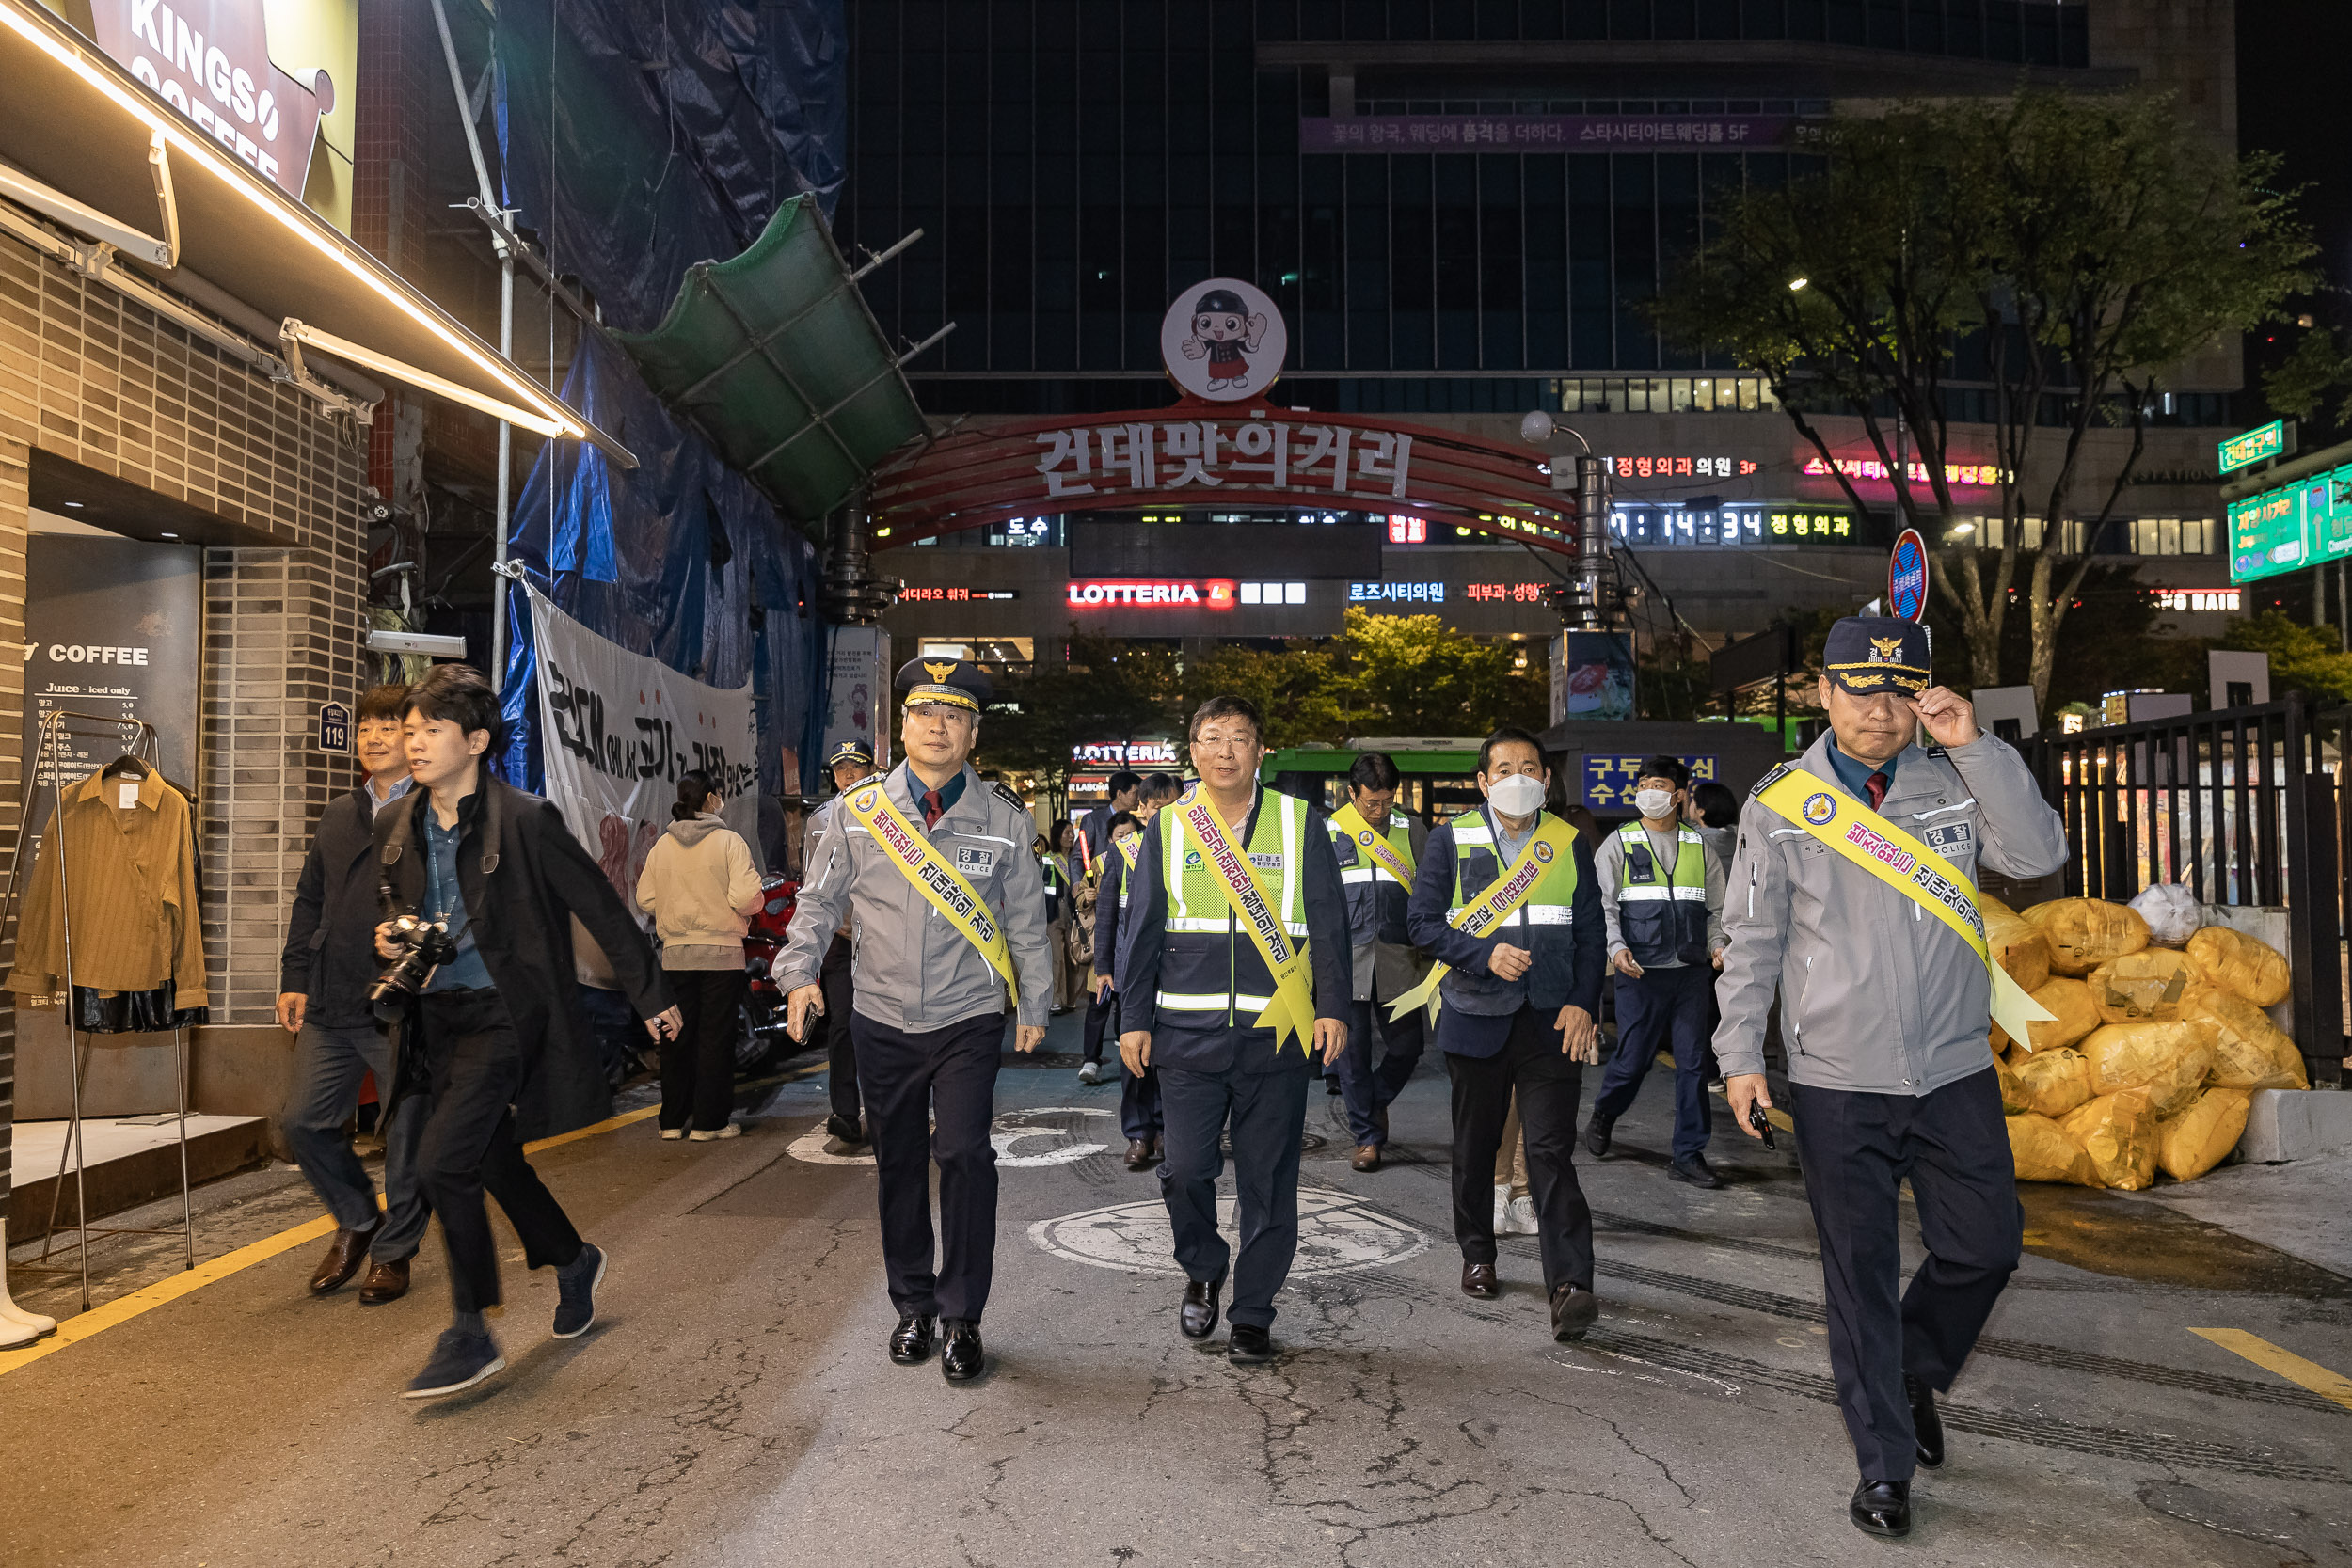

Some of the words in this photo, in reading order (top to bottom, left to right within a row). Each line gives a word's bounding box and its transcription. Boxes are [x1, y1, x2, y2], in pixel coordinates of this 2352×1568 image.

[132, 0, 256, 124] KINGS
[1515, 123, 1566, 141] 더하다.
[1580, 123, 1723, 142] 스타시티아트웨딩홀
[1728, 125, 1749, 140] 5F
[2224, 428, 2276, 466] 건대입구역
[1035, 422, 1412, 499] 건대맛의거리
[1740, 460, 1757, 474] 3F
[2237, 497, 2292, 531] 자양사거리
[1770, 515, 1851, 535] 정형외과
[946, 587, 970, 601] 훠궈
[1069, 585, 1199, 603] LOTTERIA
[1348, 582, 1445, 602] 로즈시티의원
[2191, 593, 2240, 610] HAIR
[49, 644, 149, 666] COFFEE
[45, 683, 79, 693] Juice
[88, 686, 107, 694] iced
[110, 687, 131, 696] only
[38, 699, 53, 707] 망고
[326, 726, 344, 746] 119
[1073, 745, 1176, 761] LOTTERIA
[1588, 758, 1643, 780] 구두
[1844, 821, 1916, 874] 범죄없는
[873, 810, 925, 866] 범죄없는
[917, 860, 976, 918] 건대맛의
[970, 910, 996, 942] 거리
[959, 863, 990, 873] POLICE
[1187, 804, 1230, 856] 안전하고
[1216, 849, 1254, 895] 건전한
[1241, 889, 1277, 936] 청년의
[1265, 929, 1290, 965] 거리
[1490, 860, 1540, 913] 범죄없는
